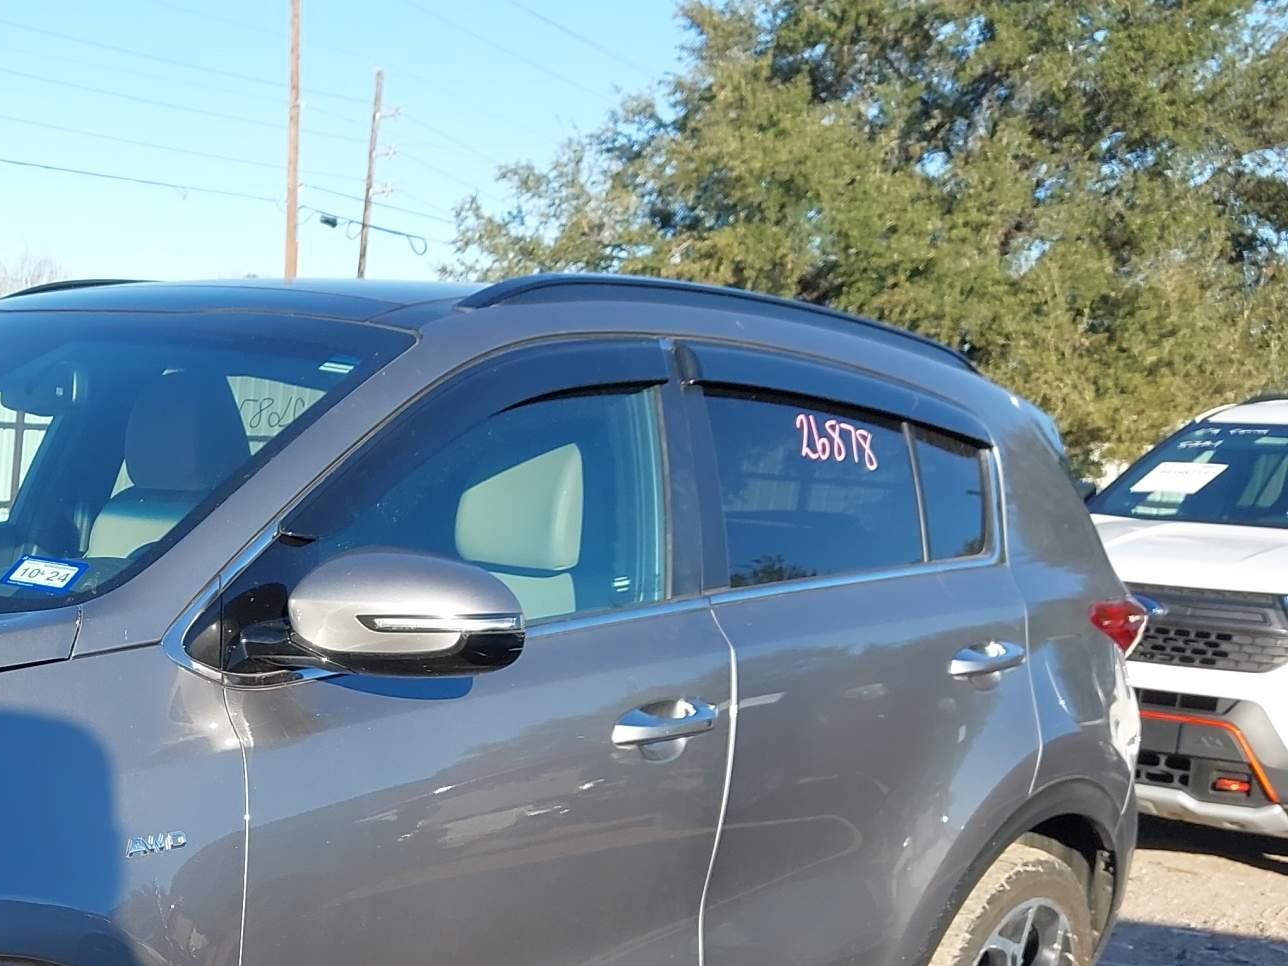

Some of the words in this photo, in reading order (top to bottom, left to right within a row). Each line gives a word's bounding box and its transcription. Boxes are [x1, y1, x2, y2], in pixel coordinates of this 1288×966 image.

[795, 413, 878, 471] 26878
[46, 570, 70, 583] 24
[125, 830, 187, 858] AWD
